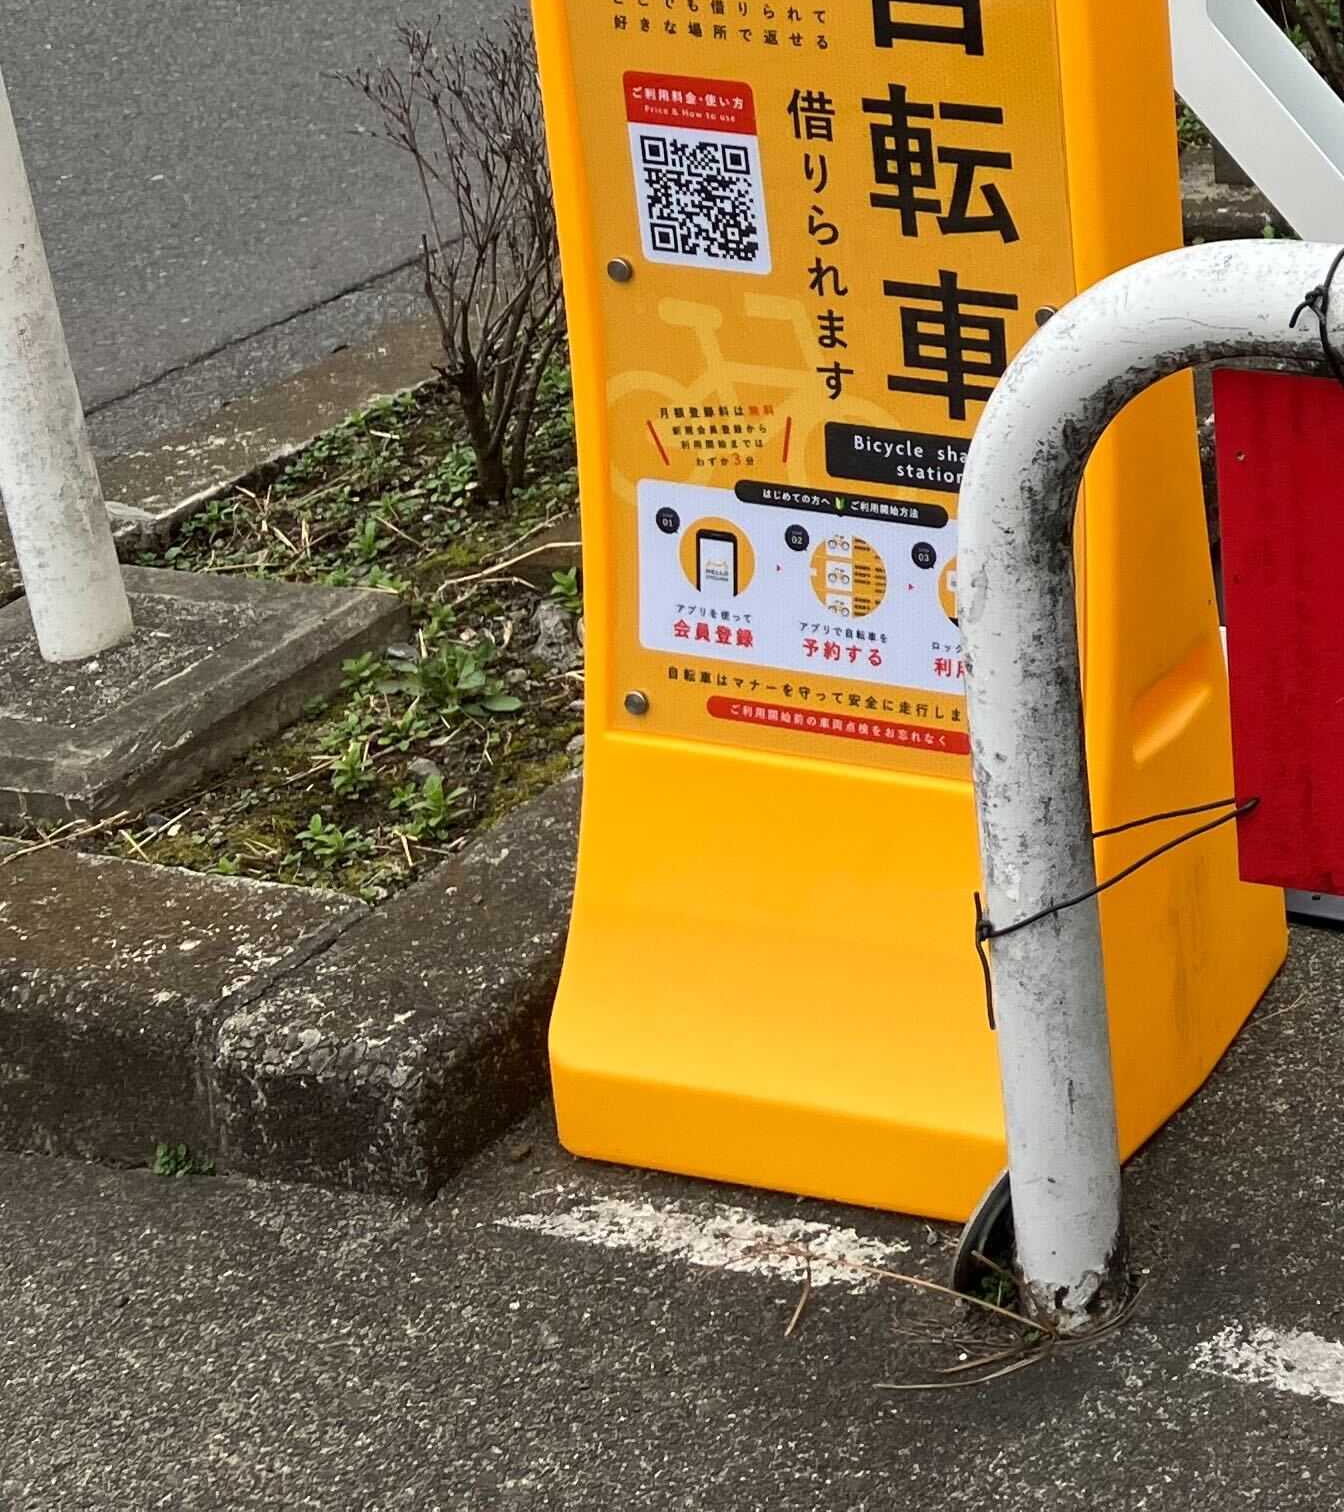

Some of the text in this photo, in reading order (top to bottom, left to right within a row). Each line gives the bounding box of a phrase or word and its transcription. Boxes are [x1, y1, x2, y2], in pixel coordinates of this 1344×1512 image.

[614, 15, 829, 49] 好きな場所で返せる
[787, 88, 855, 400] 借りられます
[854, 434, 968, 464] Bicycle sha
[762, 489, 831, 506] はじめての方へ
[662, 518, 673, 527] 01
[791, 535, 803, 545] 02
[918, 552, 930, 563] 03
[673, 619, 754, 647] 会員登録
[799, 621, 888, 644] アプリで自転車を
[802, 637, 883, 667] 予約する
[668, 666, 961, 722] 自転車はマナーを守って安全に走行しま
